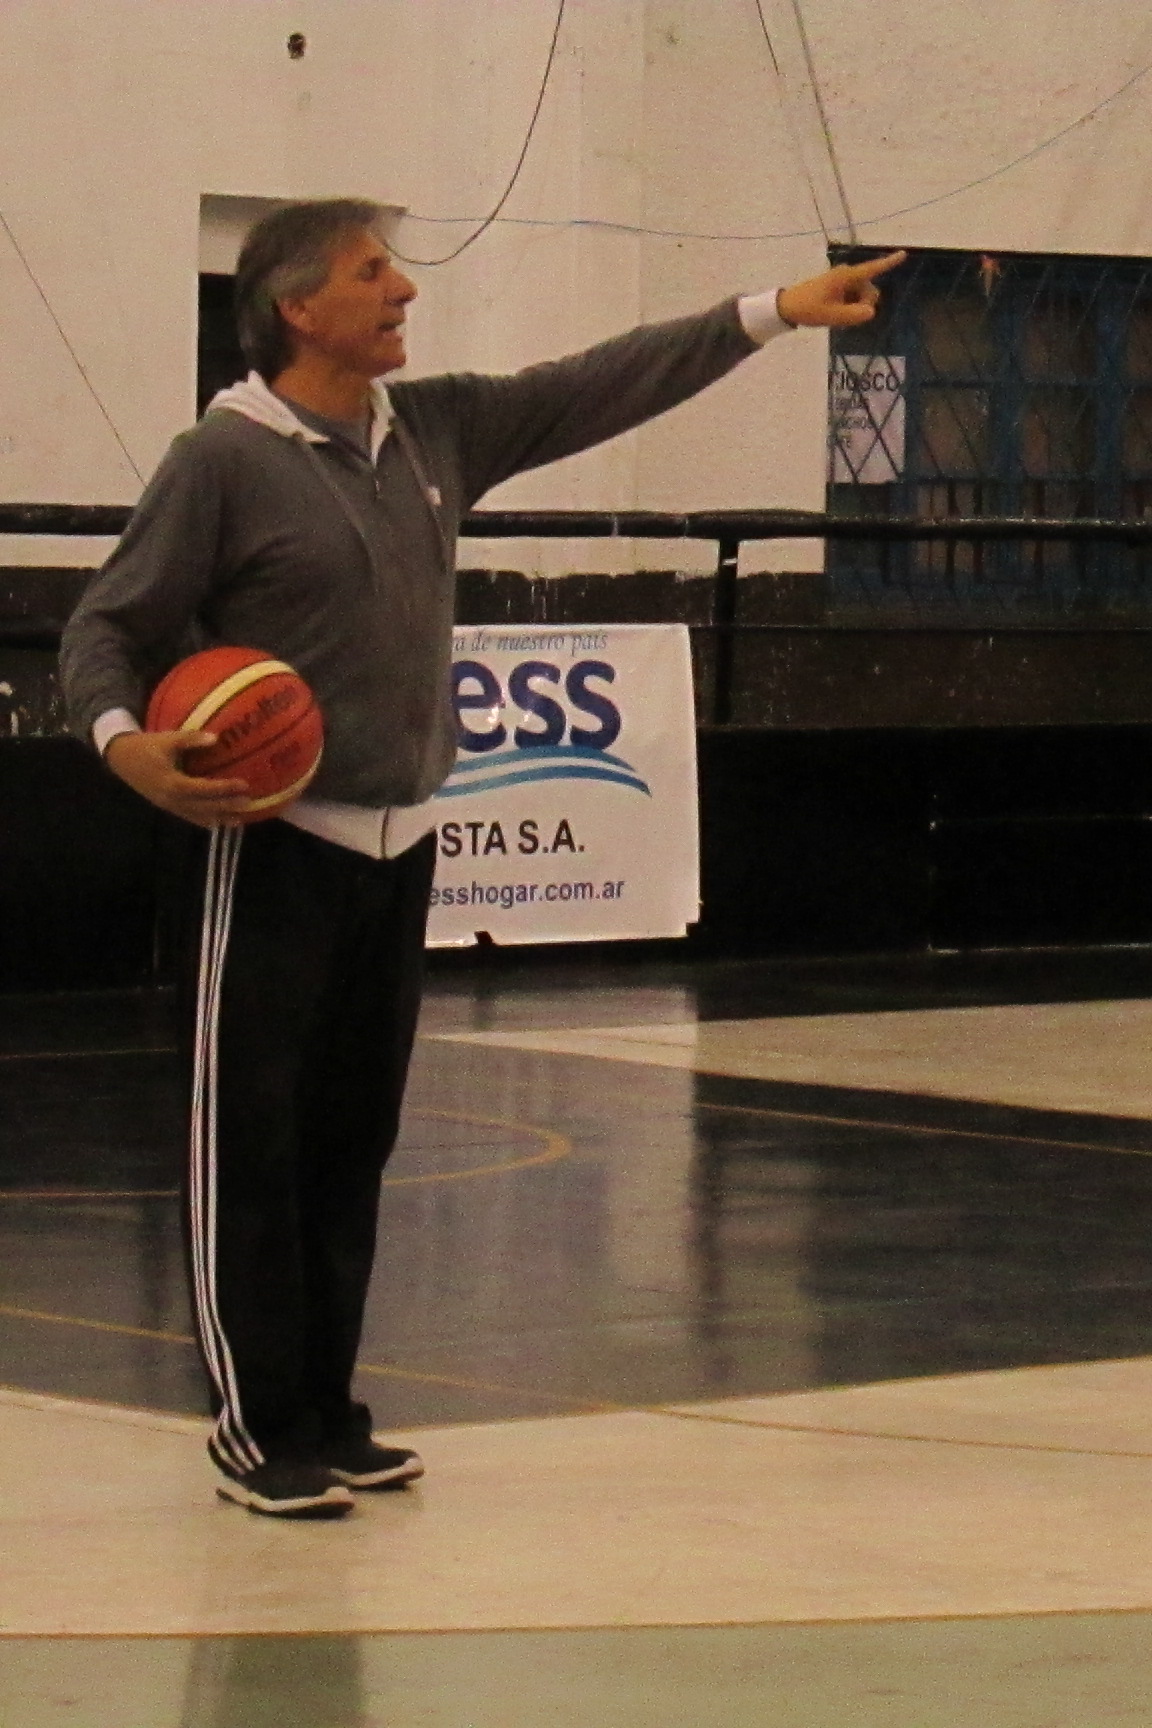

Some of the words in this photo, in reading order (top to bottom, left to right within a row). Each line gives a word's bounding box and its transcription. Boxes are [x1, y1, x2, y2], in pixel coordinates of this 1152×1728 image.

[497, 634, 565, 651] nuestro
[452, 660, 621, 752] ess
[440, 822, 507, 858] STA
[518, 818, 585, 855] S.A.
[429, 880, 625, 909] esshogar.com.ar
